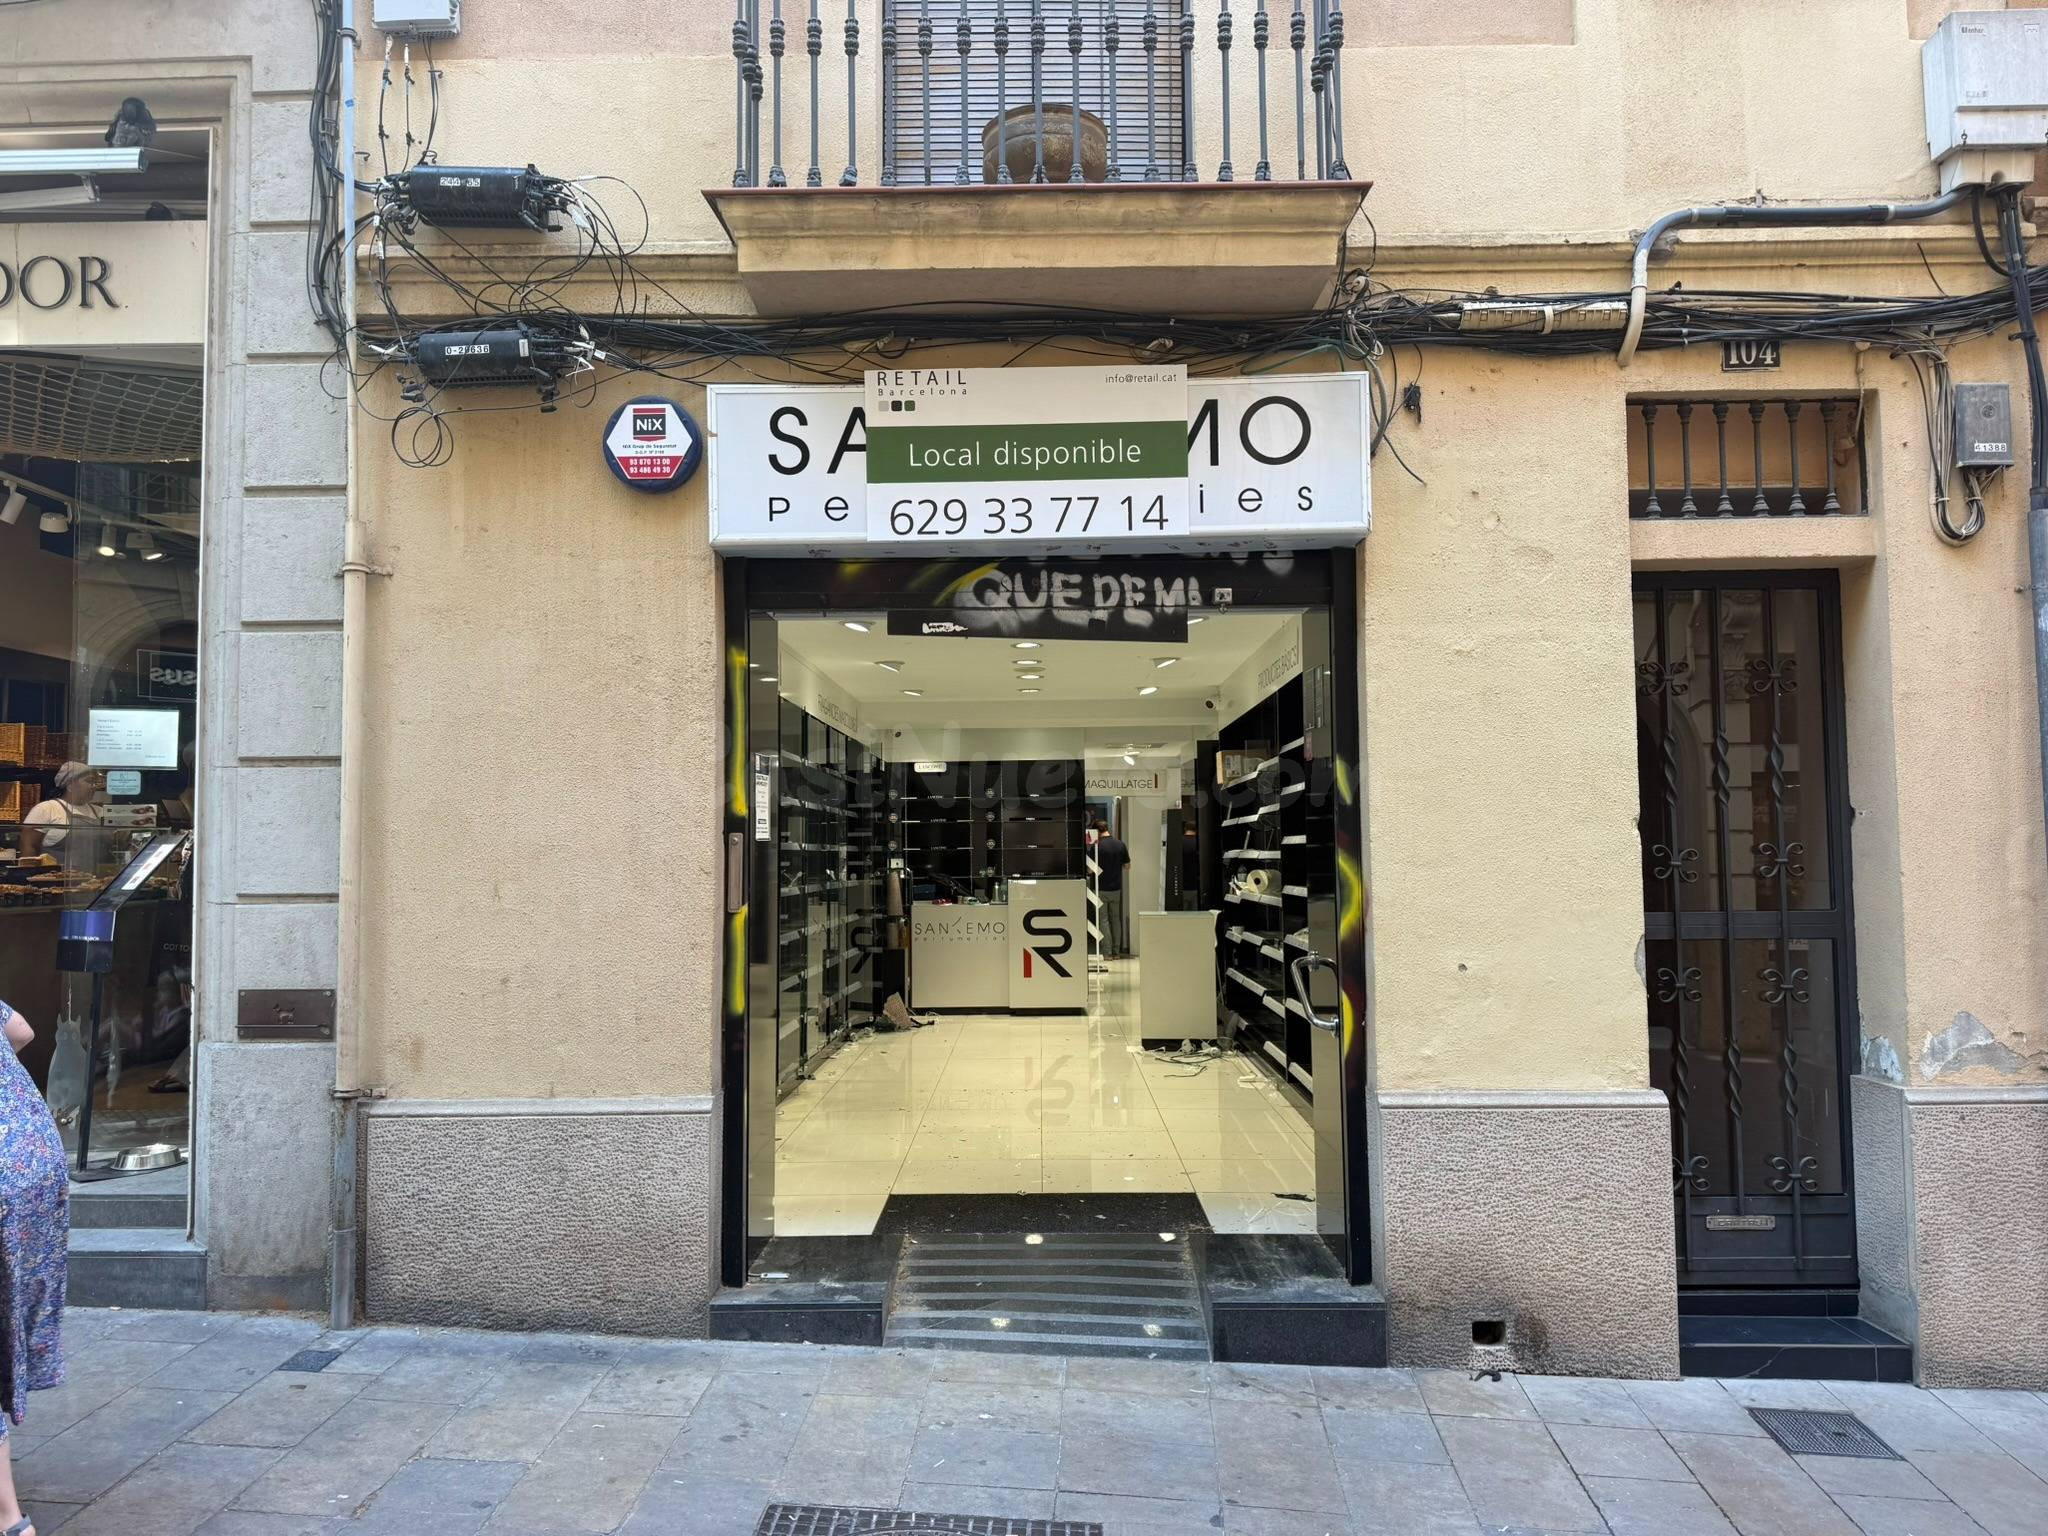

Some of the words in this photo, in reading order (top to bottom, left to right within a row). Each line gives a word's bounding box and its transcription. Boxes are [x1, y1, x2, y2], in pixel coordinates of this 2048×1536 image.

[1729, 340, 1776, 365] 104
[877, 370, 967, 386] RETAIL
[1105, 373, 1177, 384] info@retail.cat
[878, 387, 967, 396] Barcelona
[909, 440, 980, 467] Local
[994, 438, 1141, 470] disponible
[890, 498, 968, 536] 629
[984, 497, 1032, 534] 33
[1050, 495, 1099, 532] 77
[1120, 494, 1169, 531] 14
